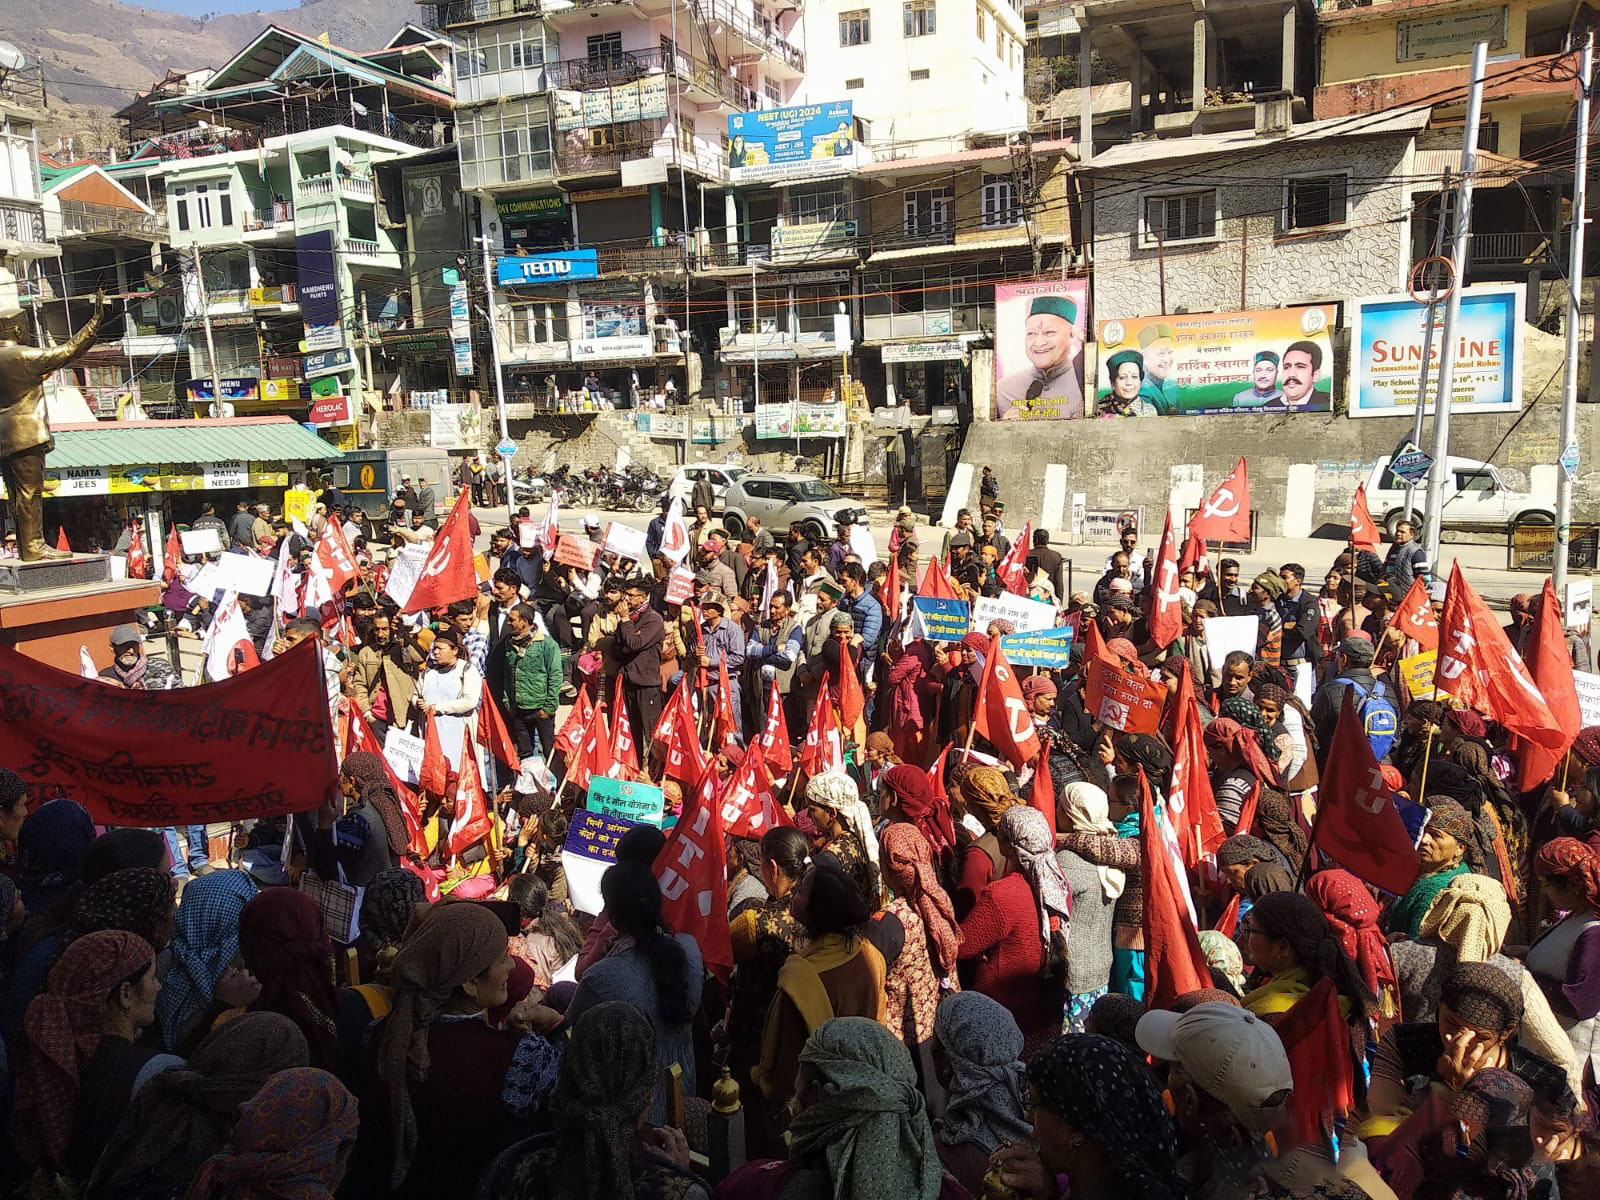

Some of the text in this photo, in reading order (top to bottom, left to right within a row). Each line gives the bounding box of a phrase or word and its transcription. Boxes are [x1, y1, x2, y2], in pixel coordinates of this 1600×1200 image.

[758, 111, 779, 122] NEET
[799, 106, 821, 117] 2024
[510, 197, 562, 213] COMMUNICATIONS
[520, 260, 572, 277] TECNO
[302, 282, 335, 294] KAMDHENU
[309, 292, 328, 300] PAINTS
[584, 345, 595, 354] ICL
[306, 354, 325, 366] KEI
[1177, 358, 1251, 371] हार्दिक स्वागत
[1453, 360, 1475, 369] chool
[1176, 372, 1251, 388] एवं अभिनन्दन
[1373, 378, 1389, 388] Play
[1475, 374, 1487, 382] +1
[1488, 374, 1499, 382] +2
[316, 402, 343, 413] NEROLAC
[67, 468, 102, 479] NAMTA
[213, 468, 239, 478] DAILY
[72, 480, 97, 489] JEES
[211, 478, 242, 487] NEEDS
[1089, 528, 1112, 536] TRAFFIC
[1007, 609, 1019, 618] राम
[1020, 610, 1029, 620] जी
[1126, 675, 1146, 692] वेतन
[627, 798, 650, 811] योजना
[650, 801, 658, 811] के
[585, 816, 604, 830] मिनी
[597, 832, 610, 843] को
[587, 844, 600, 855] का
